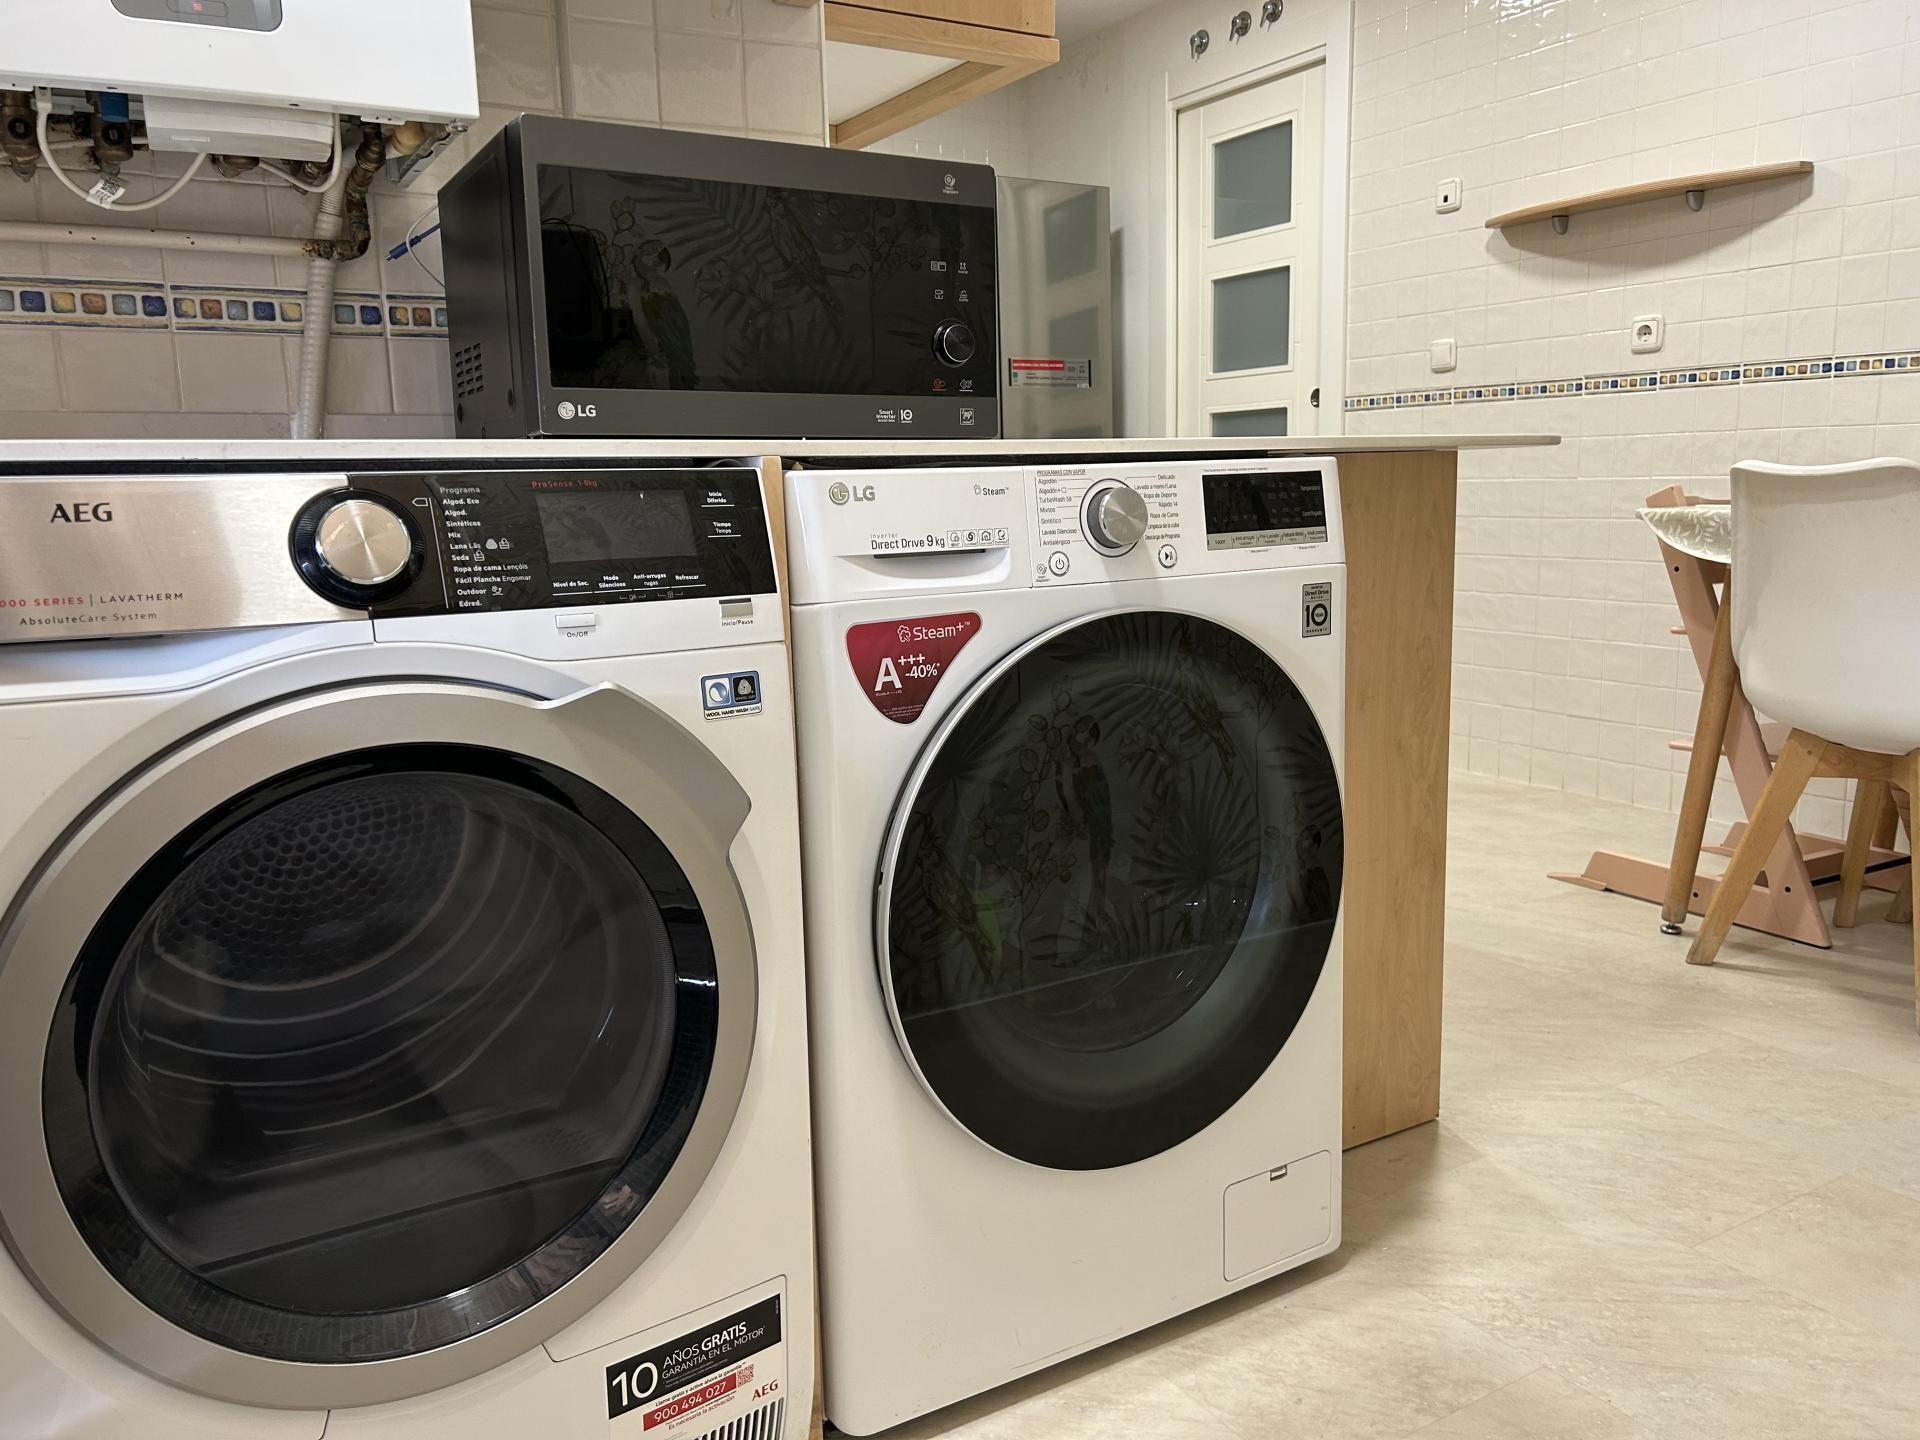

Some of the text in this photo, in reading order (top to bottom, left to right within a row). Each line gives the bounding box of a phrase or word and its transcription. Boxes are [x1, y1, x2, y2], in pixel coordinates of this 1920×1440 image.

[577, 404, 597, 417] LG
[853, 485, 875, 501] LG
[443, 498, 465, 506] Algod.
[50, 502, 113, 523] AEG
[445, 509, 468, 517] Algod.
[871, 539, 899, 550] Direct
[901, 538, 925, 549] Drive
[926, 534, 934, 547] 9
[935, 536, 945, 548] kg
[503, 563, 528, 571] Lençóis
[34, 597, 84, 607] SERIES
[100, 593, 184, 604] LAVATHERM
[457, 588, 487, 596] Outdoor
[19, 612, 157, 626] AbsoluteCare System
[1305, 603, 1328, 627] 10
[706, 710, 720, 718] WOOL
[663, 1321, 747, 1369] AÑOS GRATIS
[661, 1352, 706, 1380] GARANTÍA
[708, 1346, 721, 1360] EN
[722, 1342, 732, 1353] EL
[611, 1361, 658, 1407] 10
[752, 1379, 779, 1402] AEG
[654, 1405, 678, 1423] 900
[681, 1394, 703, 1410] 494
[705, 1381, 727, 1399] 027
